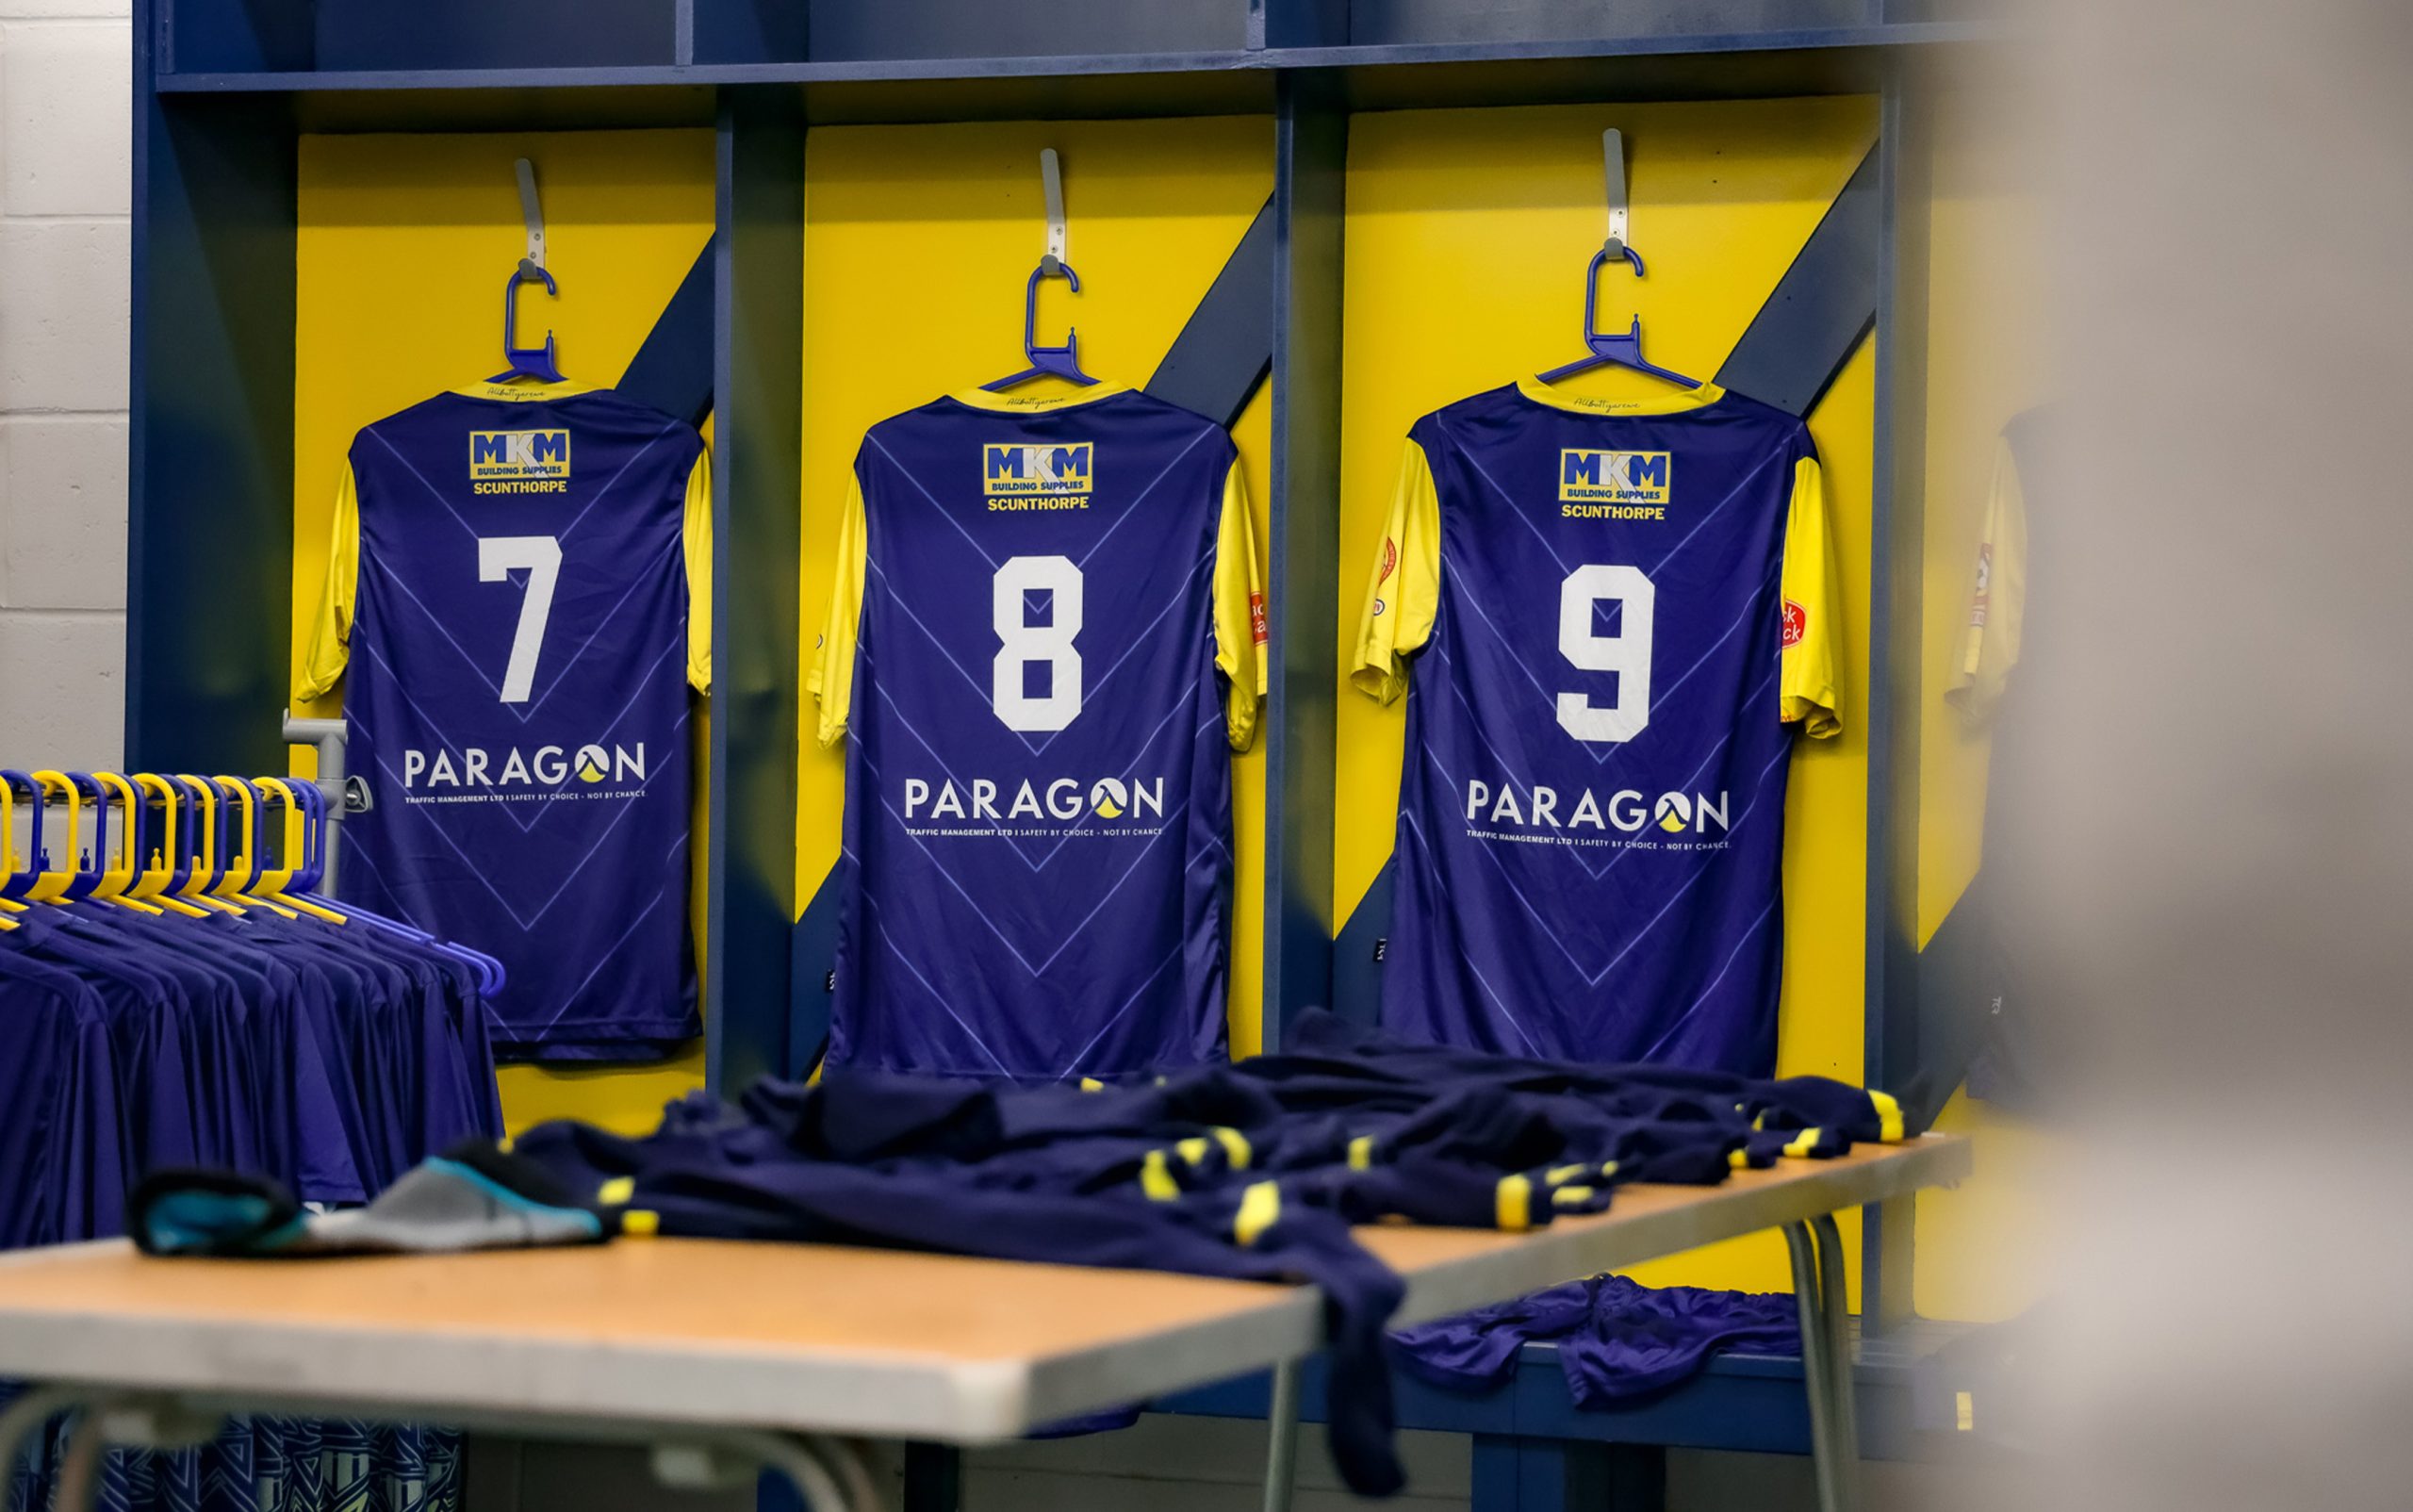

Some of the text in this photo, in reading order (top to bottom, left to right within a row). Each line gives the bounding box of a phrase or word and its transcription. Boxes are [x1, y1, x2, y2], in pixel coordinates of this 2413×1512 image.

[474, 433, 566, 478] MKM
[477, 466, 563, 475] BUILDING SUPPLIES
[988, 446, 1090, 494] MKM
[1564, 452, 1666, 503] MKM
[473, 481, 567, 495] SCUNTHORPE
[987, 496, 1090, 511] SCUNTHORPE
[992, 481, 1084, 491] BUILDING SUPPLIES
[1567, 488, 1661, 500] BUILDING SUPPLIES
[1561, 504, 1666, 520] SCUNTHORPE
[479, 536, 562, 704] 7
[993, 556, 1084, 731] 8
[1557, 565, 1655, 743] 9
[404, 742, 646, 788] PARAGON
[905, 777, 1164, 820] PARAGON
[1467, 779, 1729, 833] PARAGON
[1466, 830, 1497, 840] TRAFFIC
[1499, 833, 1555, 845] MANAGEMENT
[1556, 837, 1572, 846] LTD
[1581, 838, 1609, 847] SAFETY
[1624, 841, 1658, 849] CHOICE
[1683, 843, 1693, 851] BY
